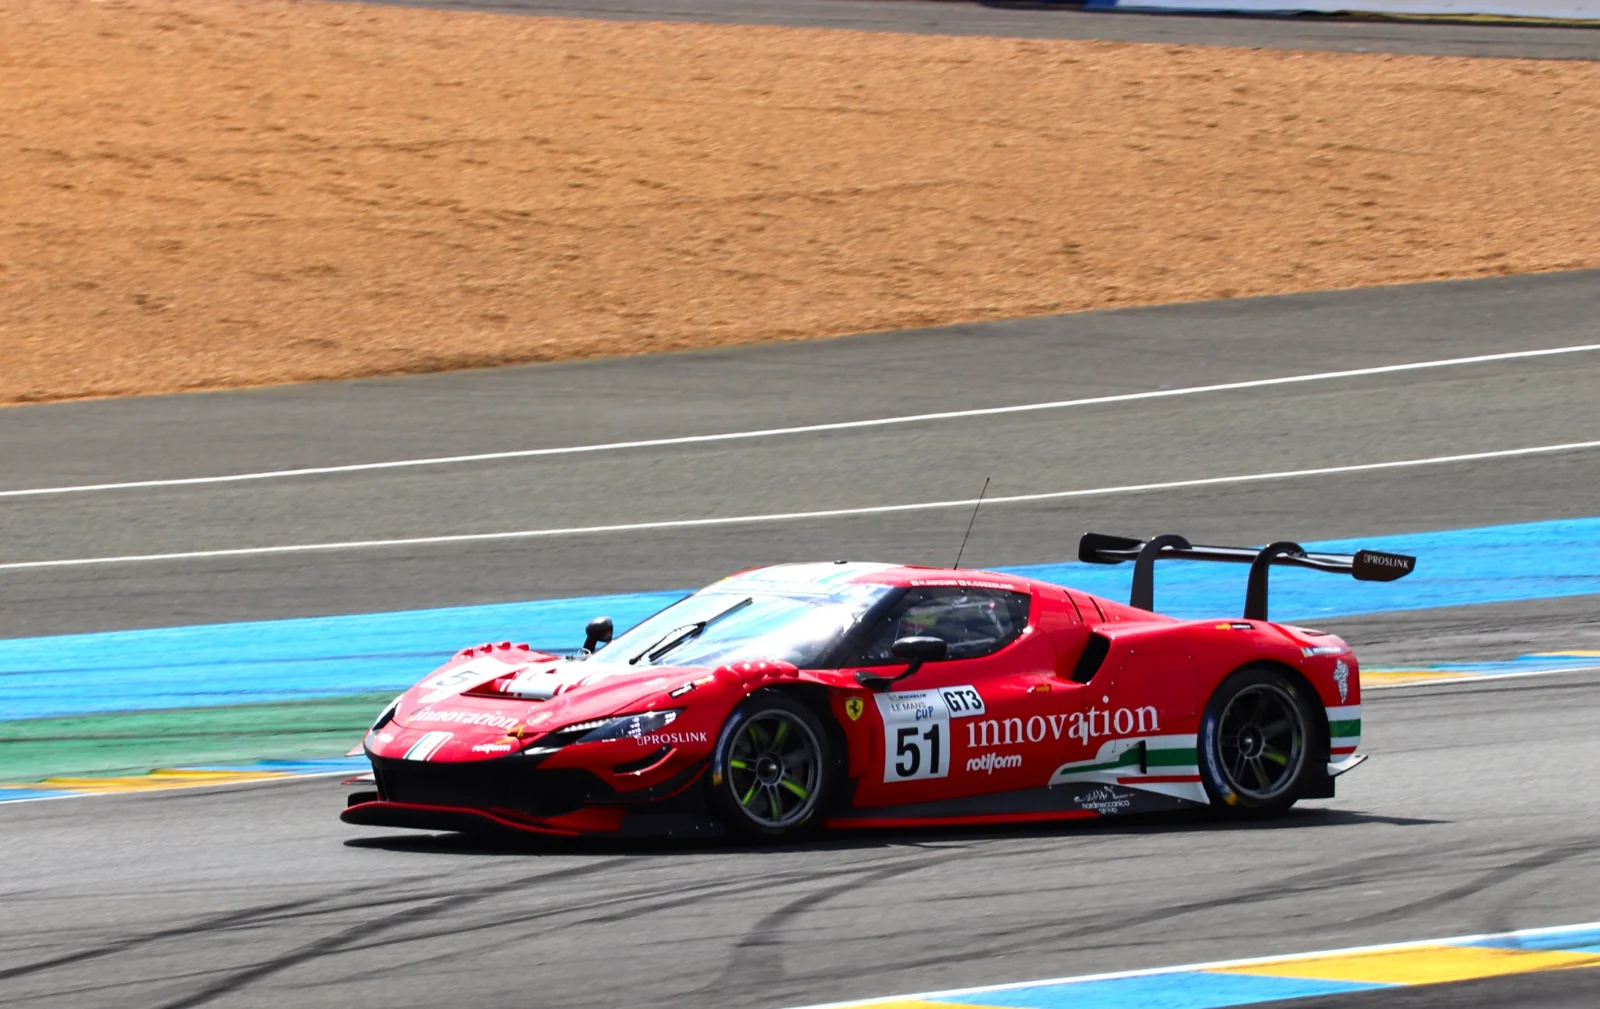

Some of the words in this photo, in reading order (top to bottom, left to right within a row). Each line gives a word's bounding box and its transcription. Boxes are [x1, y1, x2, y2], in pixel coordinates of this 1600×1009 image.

[1367, 555, 1409, 568] PROSLINK
[891, 703, 901, 712] LE
[943, 689, 984, 713] GT3
[411, 706, 520, 729] innovation
[915, 706, 934, 721] CUP
[966, 695, 1160, 748] innovation
[643, 731, 708, 746] PROSLINK
[895, 723, 940, 778] 51
[965, 752, 1022, 775] rotiform
